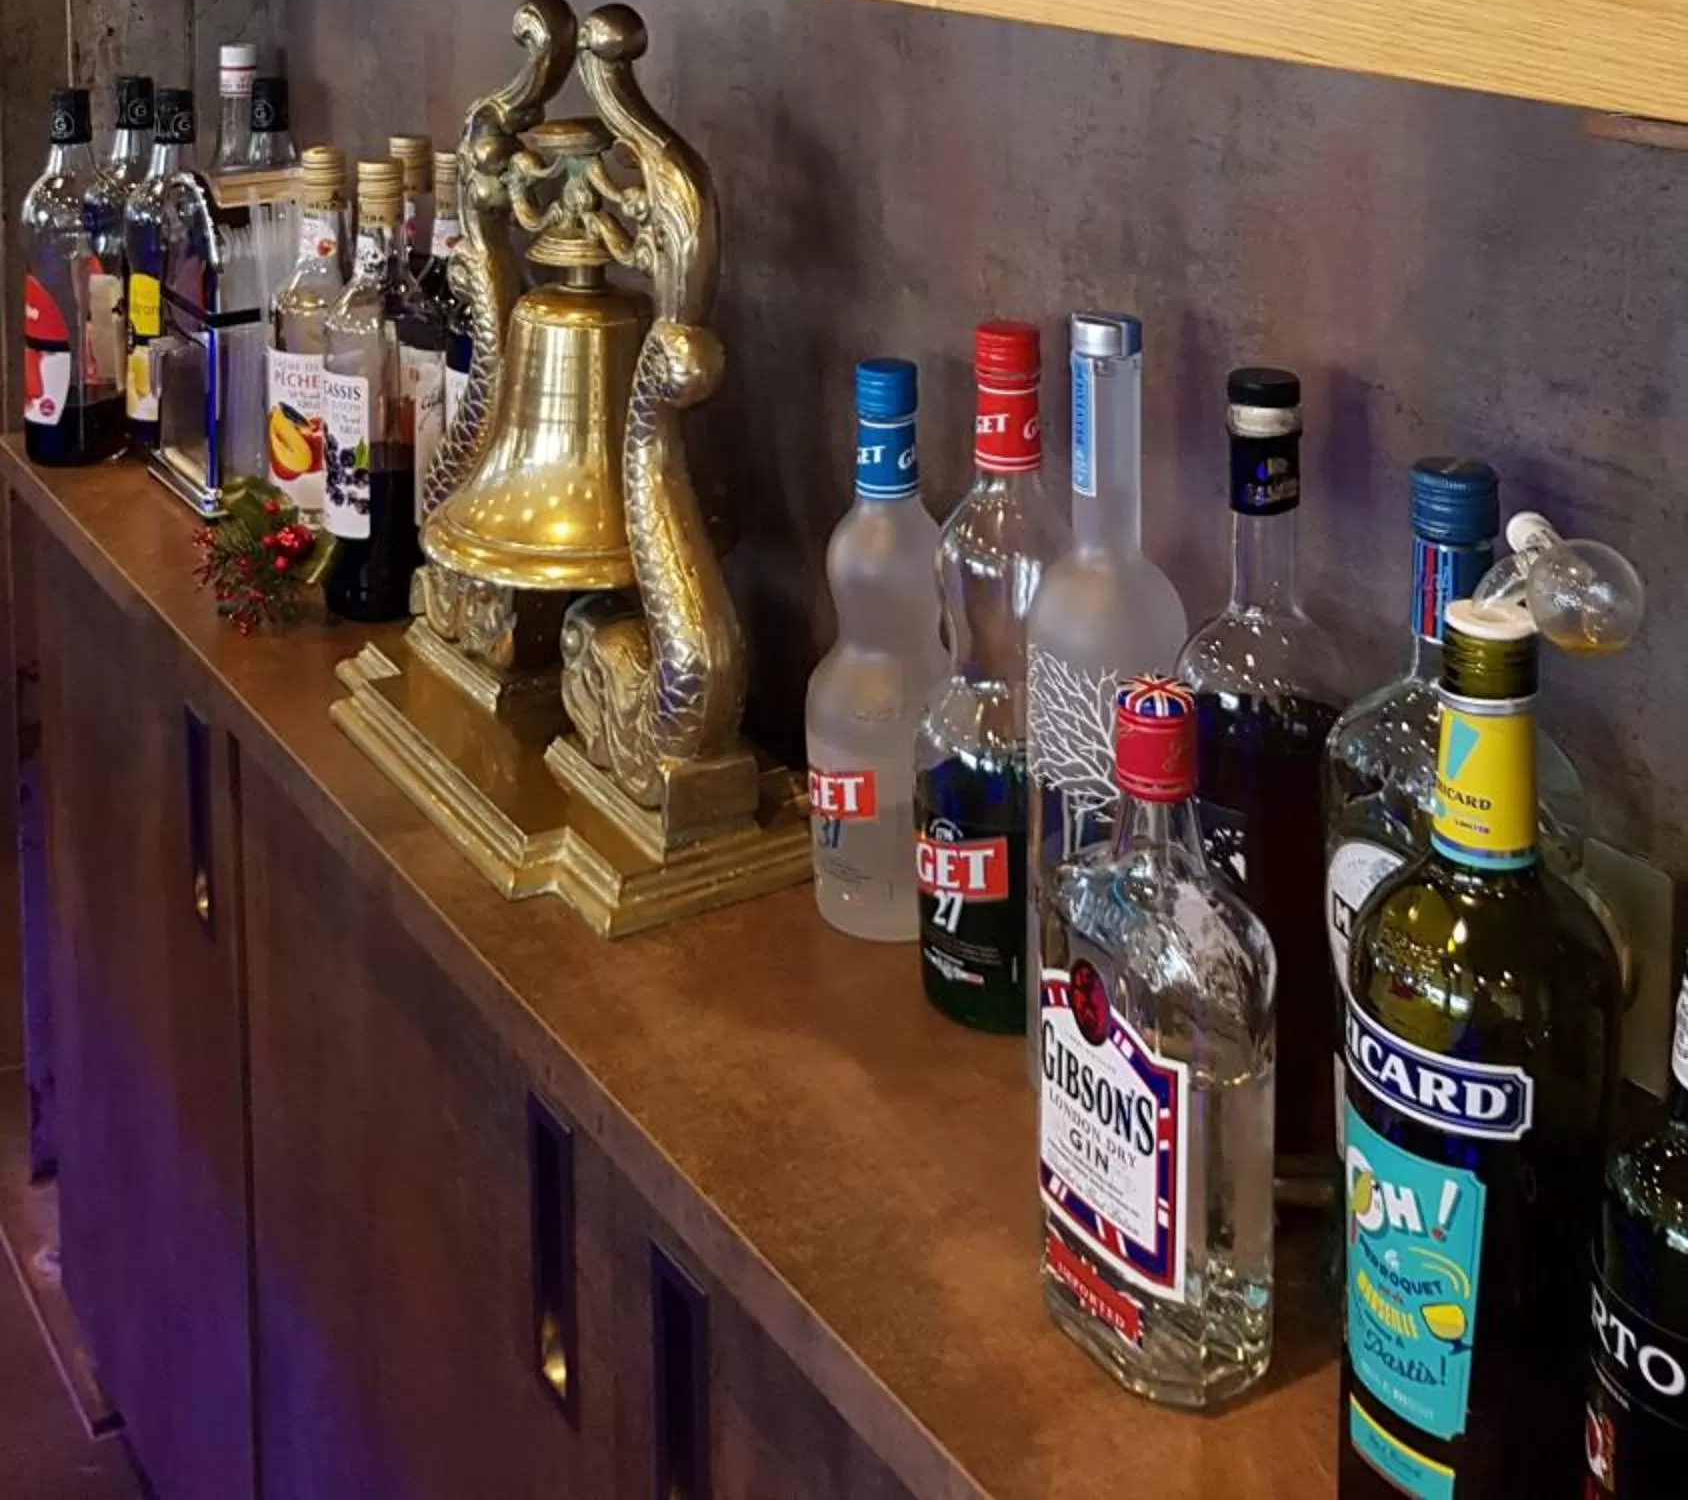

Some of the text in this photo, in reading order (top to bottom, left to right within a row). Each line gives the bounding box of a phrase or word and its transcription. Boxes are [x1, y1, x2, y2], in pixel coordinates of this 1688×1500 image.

[809, 771, 865, 812] GET
[916, 842, 995, 891] GET
[932, 890, 964, 933] 27
[1042, 1019, 1155, 1157] GIBSON'S
[1346, 1013, 1508, 1120] ICARD
[1049, 1087, 1138, 1169] LONDON DRY
[1068, 1127, 1110, 1175] GIN
